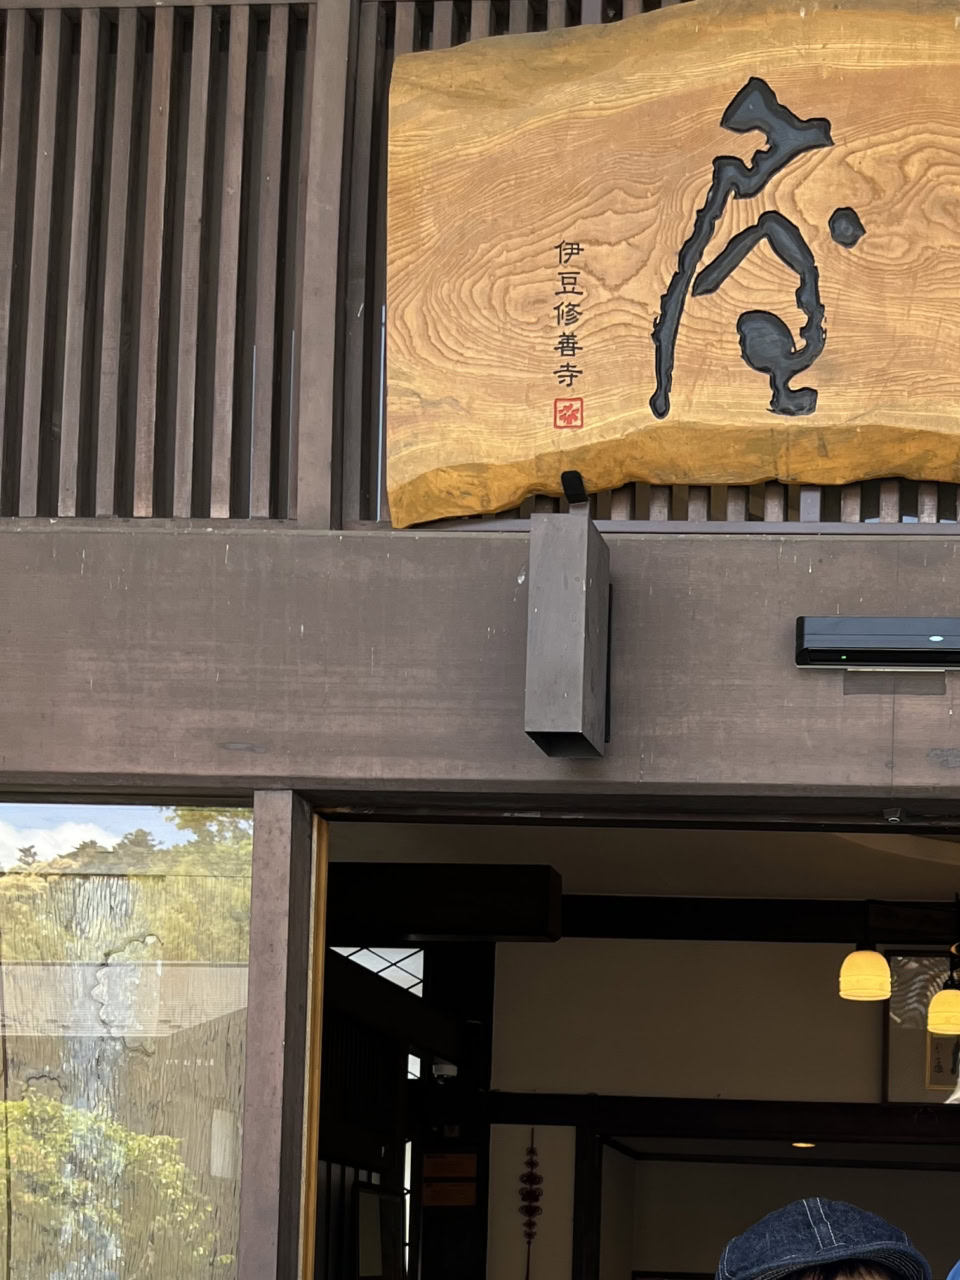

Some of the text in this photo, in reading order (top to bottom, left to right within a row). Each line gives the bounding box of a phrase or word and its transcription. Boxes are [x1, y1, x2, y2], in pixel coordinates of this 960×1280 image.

[553, 239, 585, 388] 伊豆修善寺
